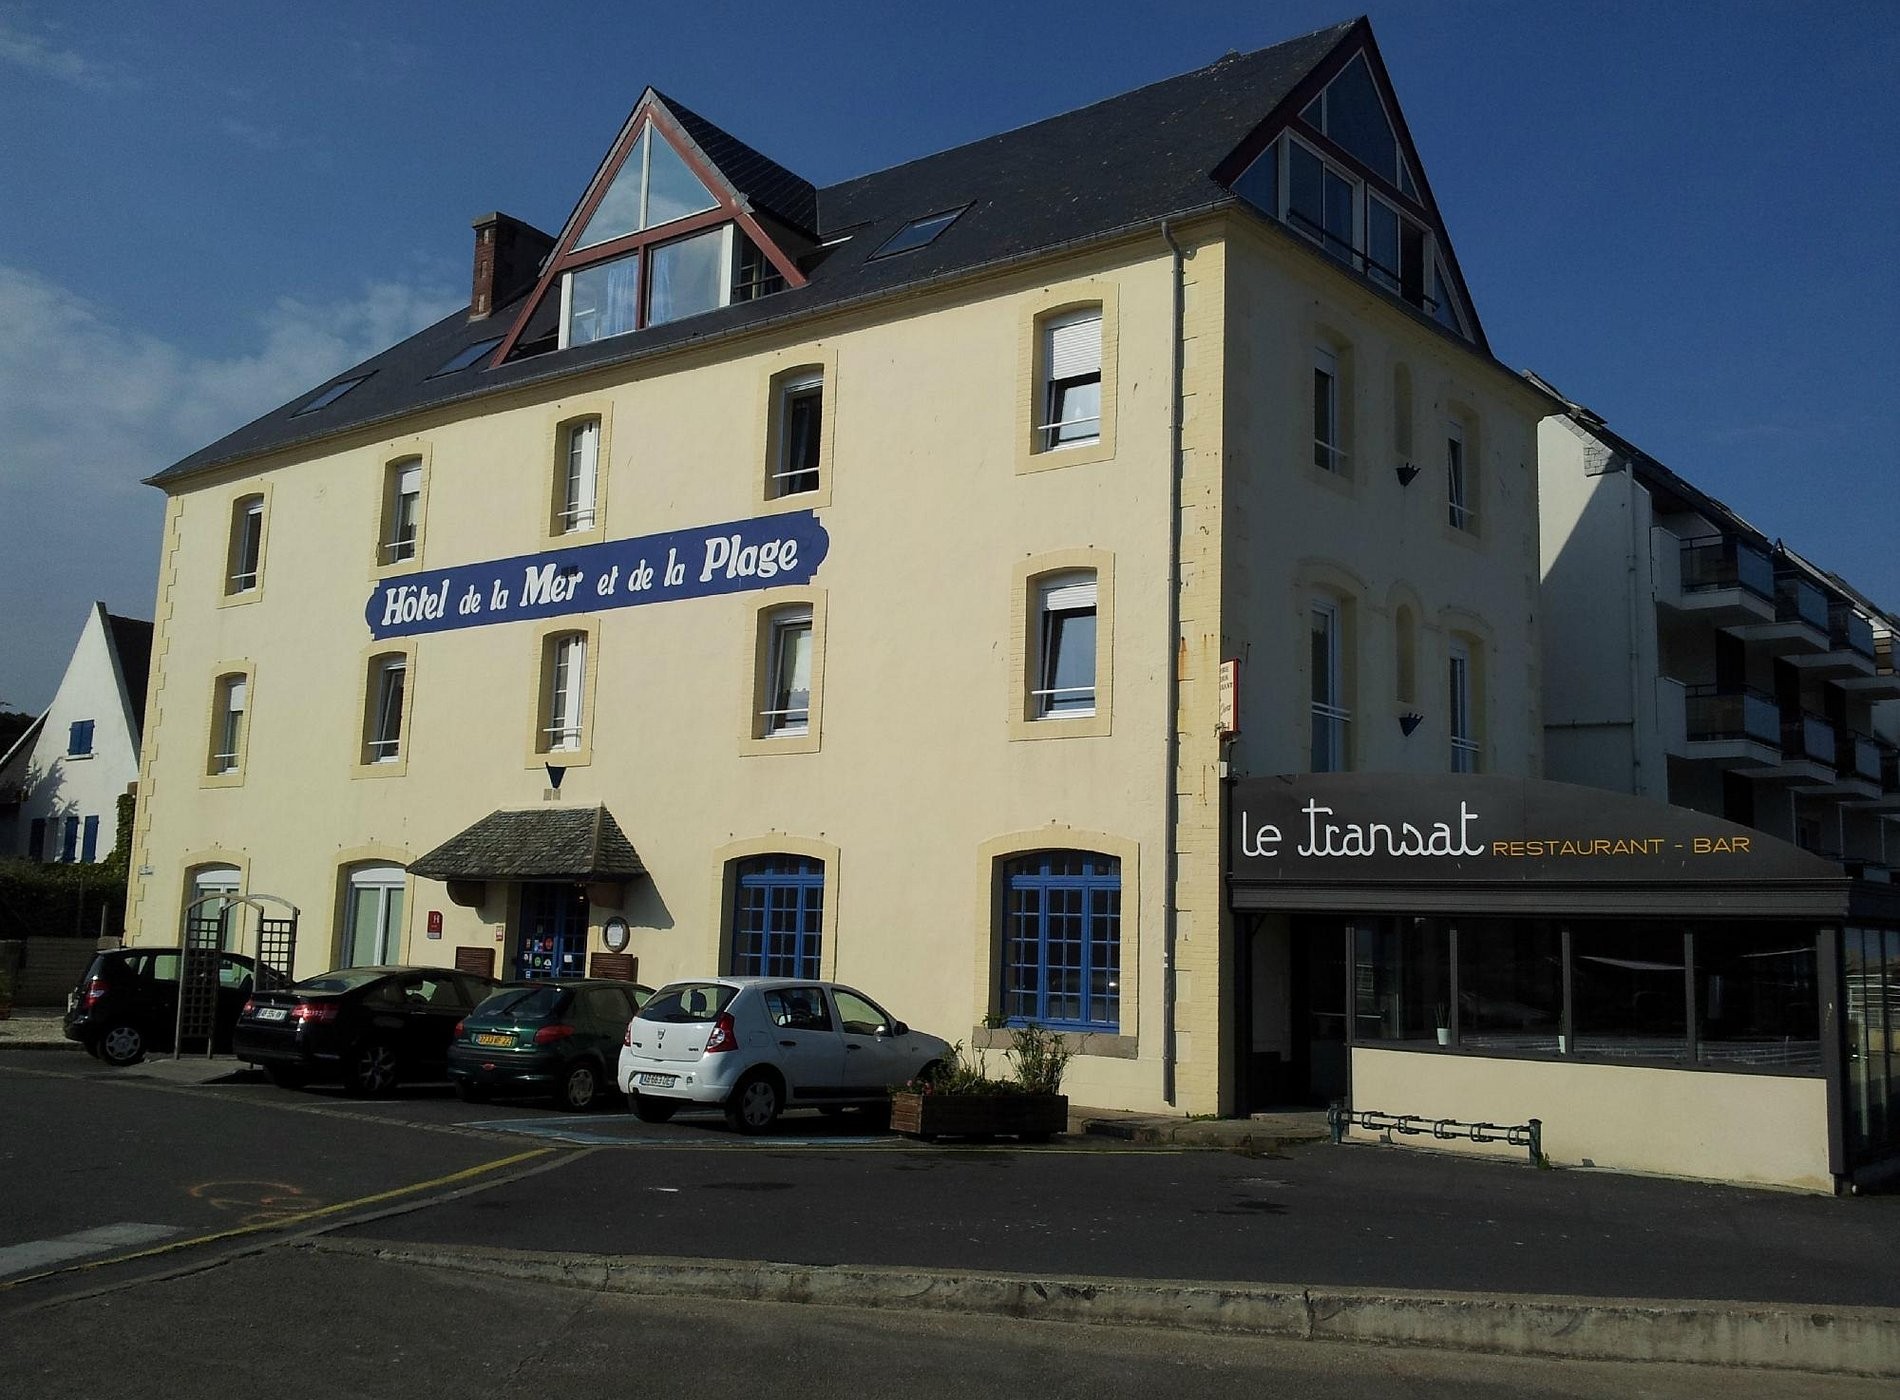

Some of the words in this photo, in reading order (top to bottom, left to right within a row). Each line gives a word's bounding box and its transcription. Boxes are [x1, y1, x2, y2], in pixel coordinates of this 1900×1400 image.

[381, 579, 450, 625] Hôtel
[459, 586, 481, 615] de
[489, 580, 508, 610] la
[520, 563, 583, 607] Mer
[597, 569, 618, 595] et
[627, 559, 652, 590] de
[661, 548, 686, 585] la
[699, 537, 799, 582] Plage
[1242, 811, 1282, 857] le
[1298, 798, 1485, 857] transat
[1492, 839, 1665, 856] RESTAURANT
[1694, 837, 1750, 854] BAR
